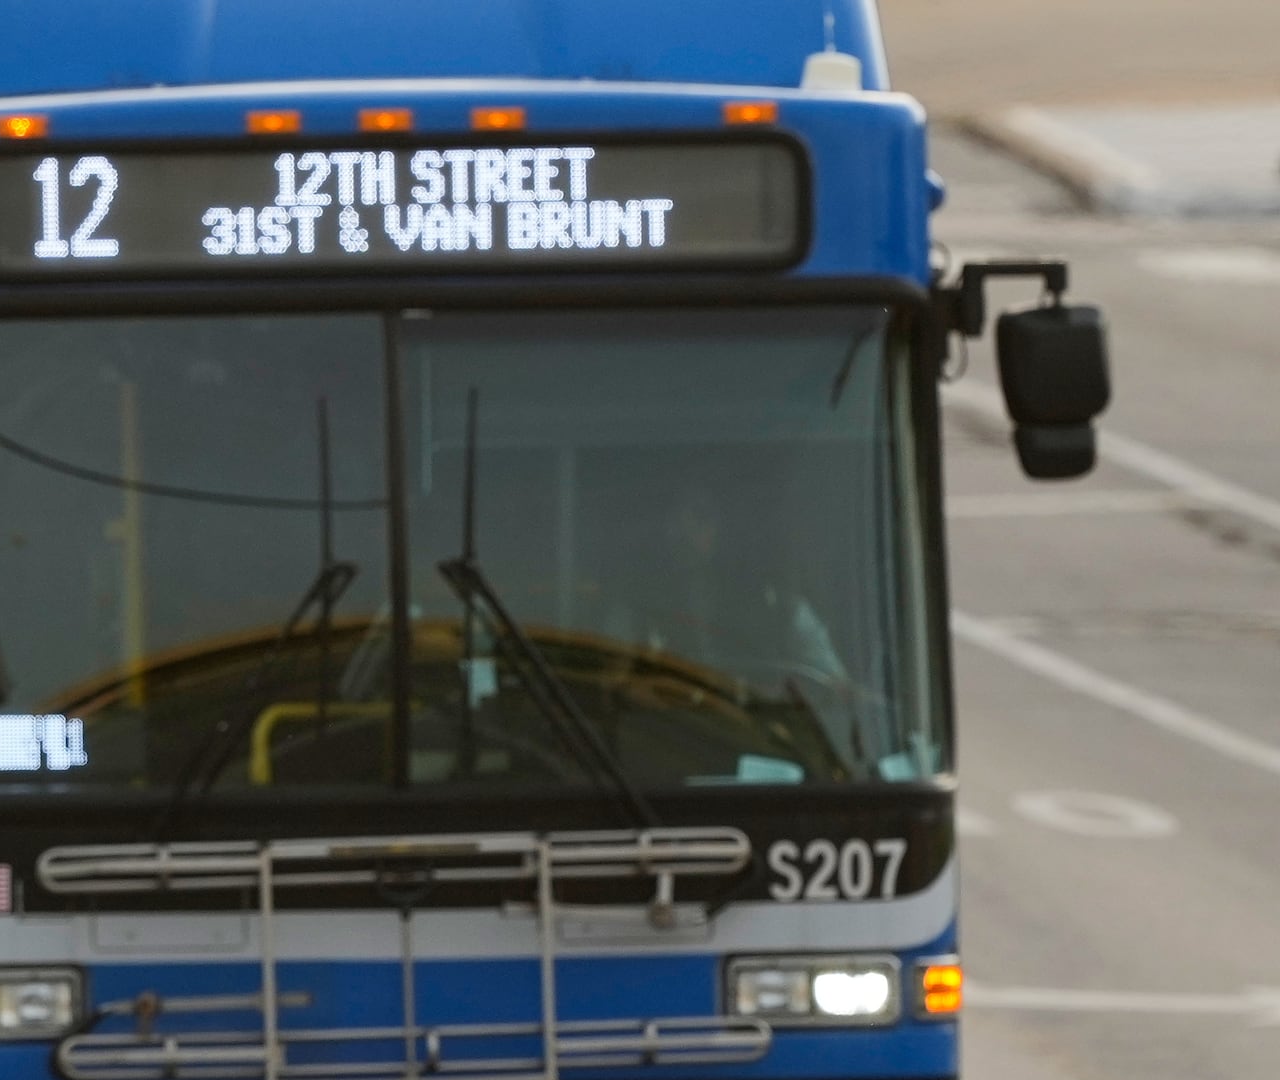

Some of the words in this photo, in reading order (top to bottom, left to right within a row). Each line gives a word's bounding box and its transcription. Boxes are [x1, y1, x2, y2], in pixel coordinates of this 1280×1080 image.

[274, 151, 396, 206] 12TH
[411, 147, 595, 202] STREET
[33, 156, 120, 258] 12
[202, 206, 323, 255] 31ST
[339, 205, 369, 252] &
[384, 203, 492, 250] VAN
[508, 199, 674, 250] BRUNT
[768, 839, 907, 900] S207
